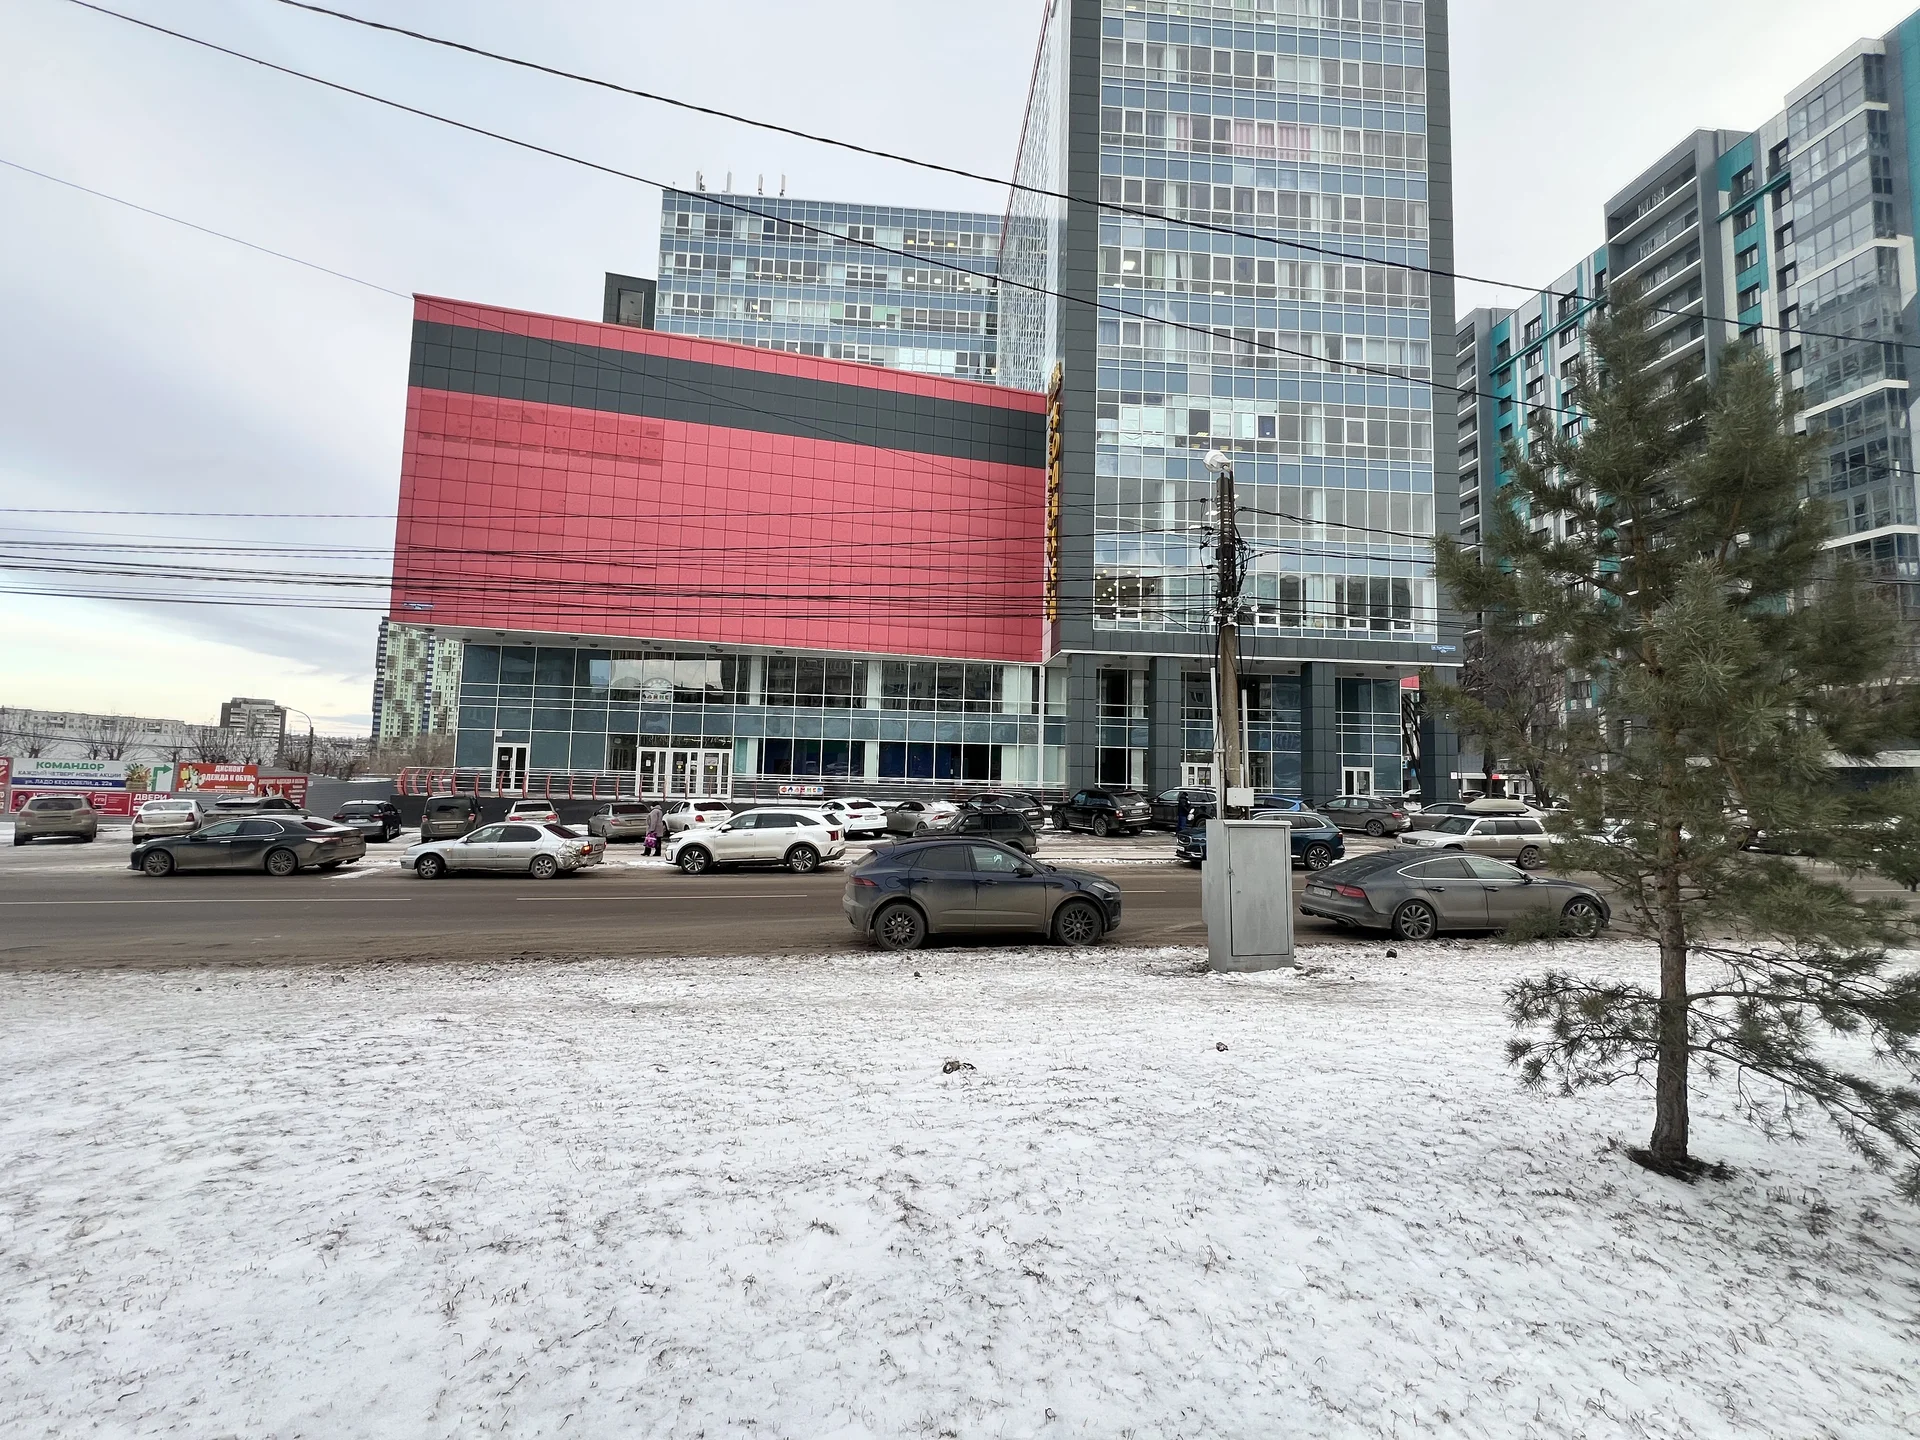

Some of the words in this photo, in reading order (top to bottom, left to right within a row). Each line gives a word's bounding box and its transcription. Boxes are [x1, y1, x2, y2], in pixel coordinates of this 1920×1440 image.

[36, 761, 105, 771] КОМАНДОР
[214, 764, 245, 773] ДИСКОНТ
[201, 773, 229, 782] ОДЕЖДА
[235, 773, 256, 782] ОБУВЬ
[133, 793, 168, 801] ДВЕРИ
